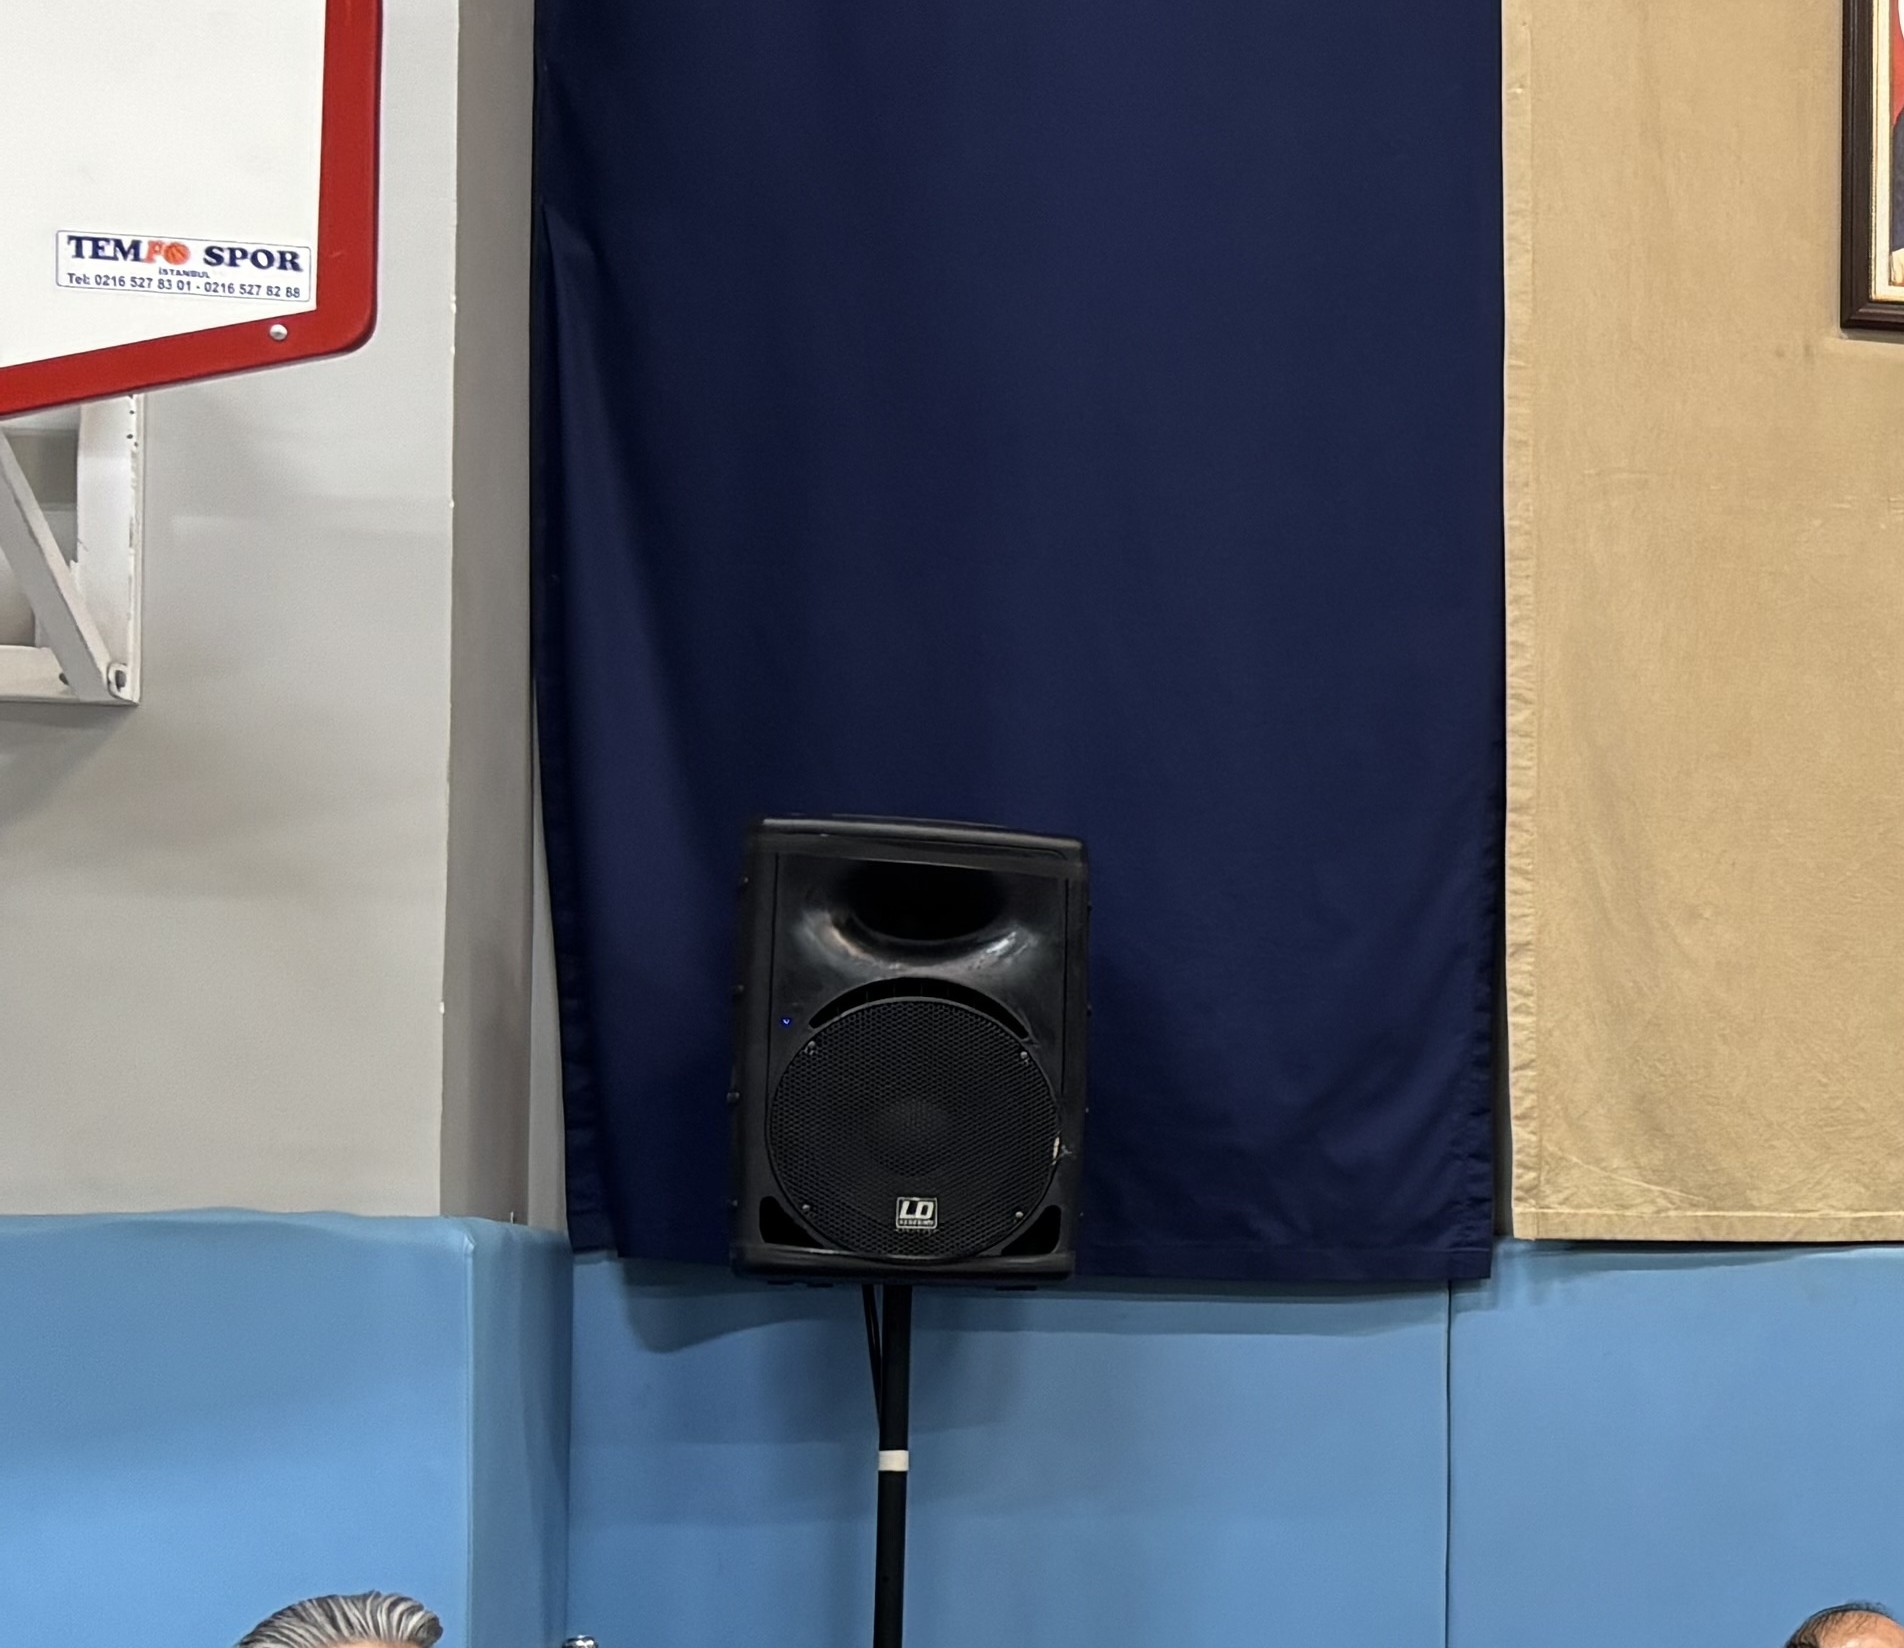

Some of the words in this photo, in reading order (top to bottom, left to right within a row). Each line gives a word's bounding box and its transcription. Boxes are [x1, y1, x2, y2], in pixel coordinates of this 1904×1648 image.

[203, 245, 304, 273] SPOR
[95, 274, 126, 287] 0216
[130, 276, 153, 289] 527
[177, 279, 191, 291] 01
[204, 281, 235, 294] 0216
[239, 283, 262, 296] 527
